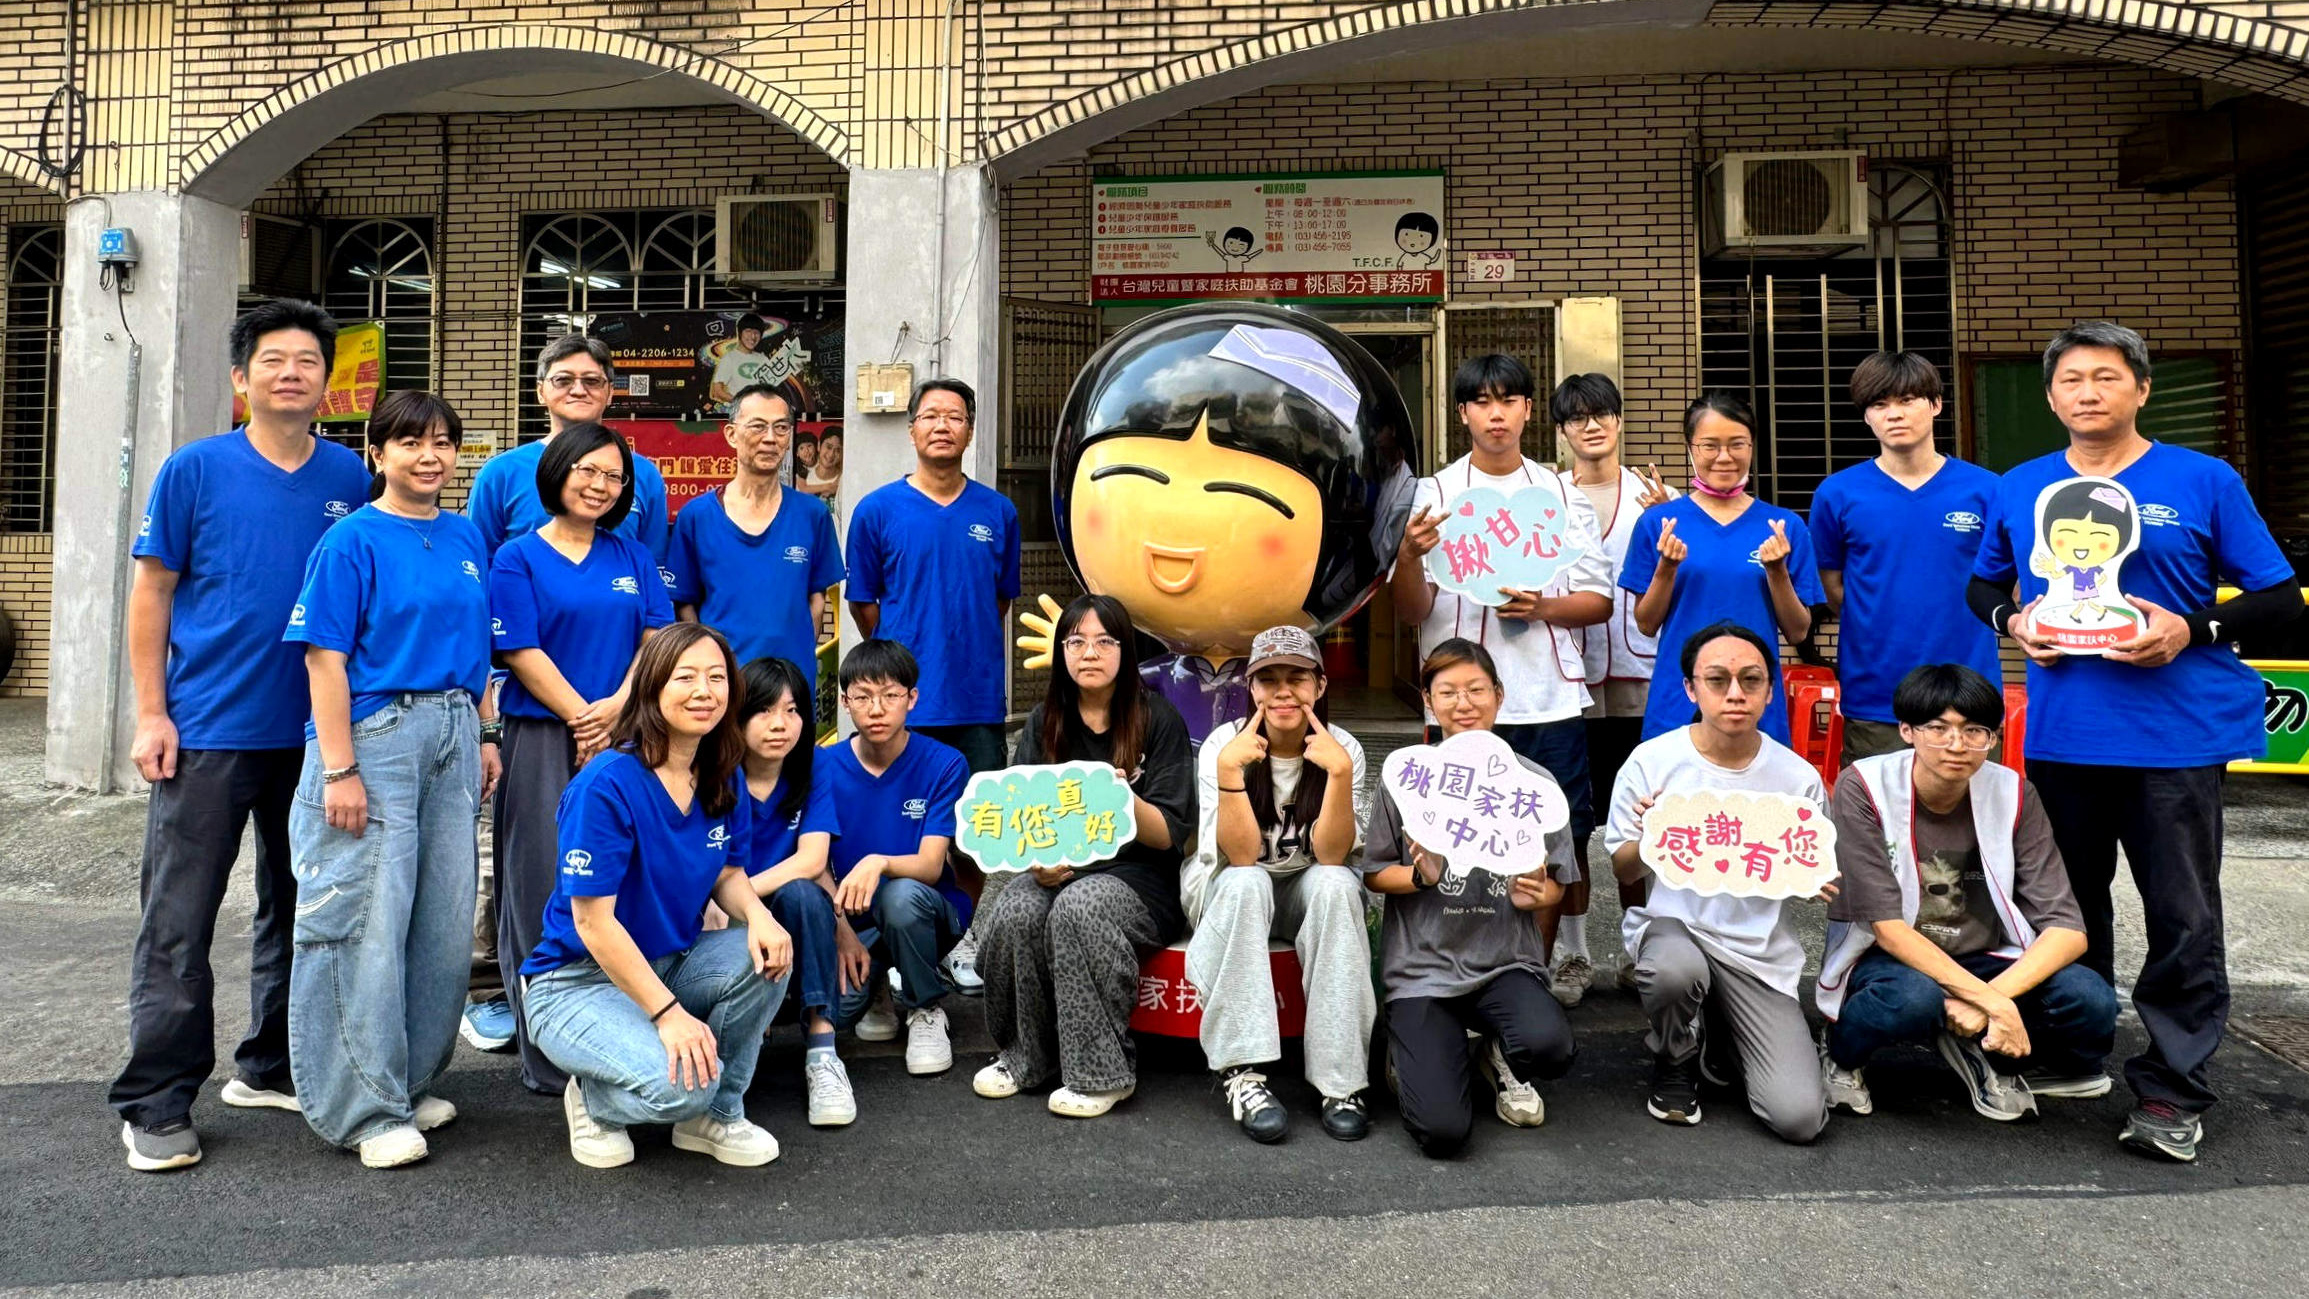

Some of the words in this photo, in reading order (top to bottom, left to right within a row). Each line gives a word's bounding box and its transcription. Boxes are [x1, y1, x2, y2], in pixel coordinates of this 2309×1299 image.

[1352, 257, 1394, 268] T.F.C.F.
[1484, 264, 1505, 279] 29
[1122, 277, 1298, 293] 台灣兒童暨家庭扶助基金會
[1304, 272, 1433, 294] 桃園分事務所
[623, 347, 695, 358] 04-2206-1234
[1946, 511, 1980, 524] Ford
[1397, 757, 1544, 824] 桃園家扶
[969, 778, 1117, 857] 有您真好
[1446, 817, 1510, 857] 中心
[1655, 810, 1819, 883] 感謝有您
